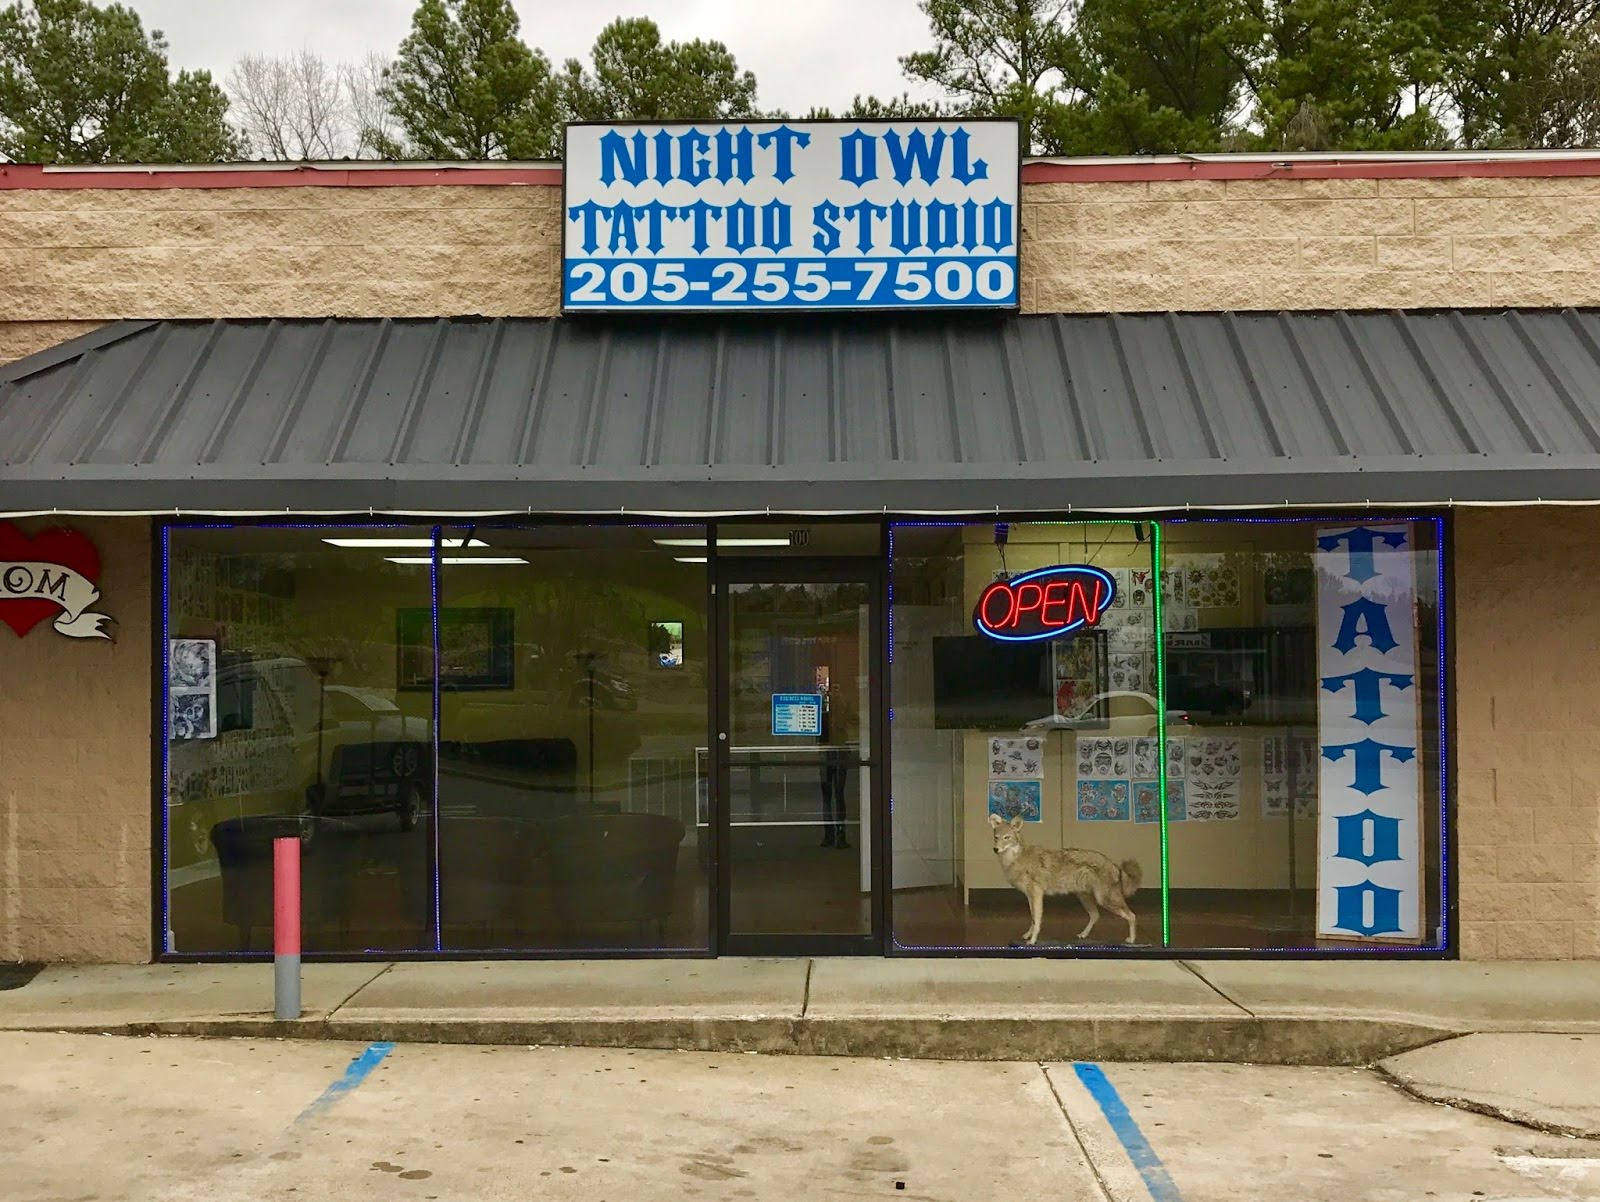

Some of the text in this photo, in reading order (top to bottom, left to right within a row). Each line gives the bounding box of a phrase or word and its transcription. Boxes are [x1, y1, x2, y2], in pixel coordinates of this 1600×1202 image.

[599, 125, 988, 188] NIGHT OWL
[568, 196, 1014, 256] TATTOO STUDIO
[570, 261, 1015, 302] 205-255-7500
[0, 566, 70, 601] OM
[981, 578, 1100, 627] OPEN
[1316, 526, 1416, 936] TATTOO
